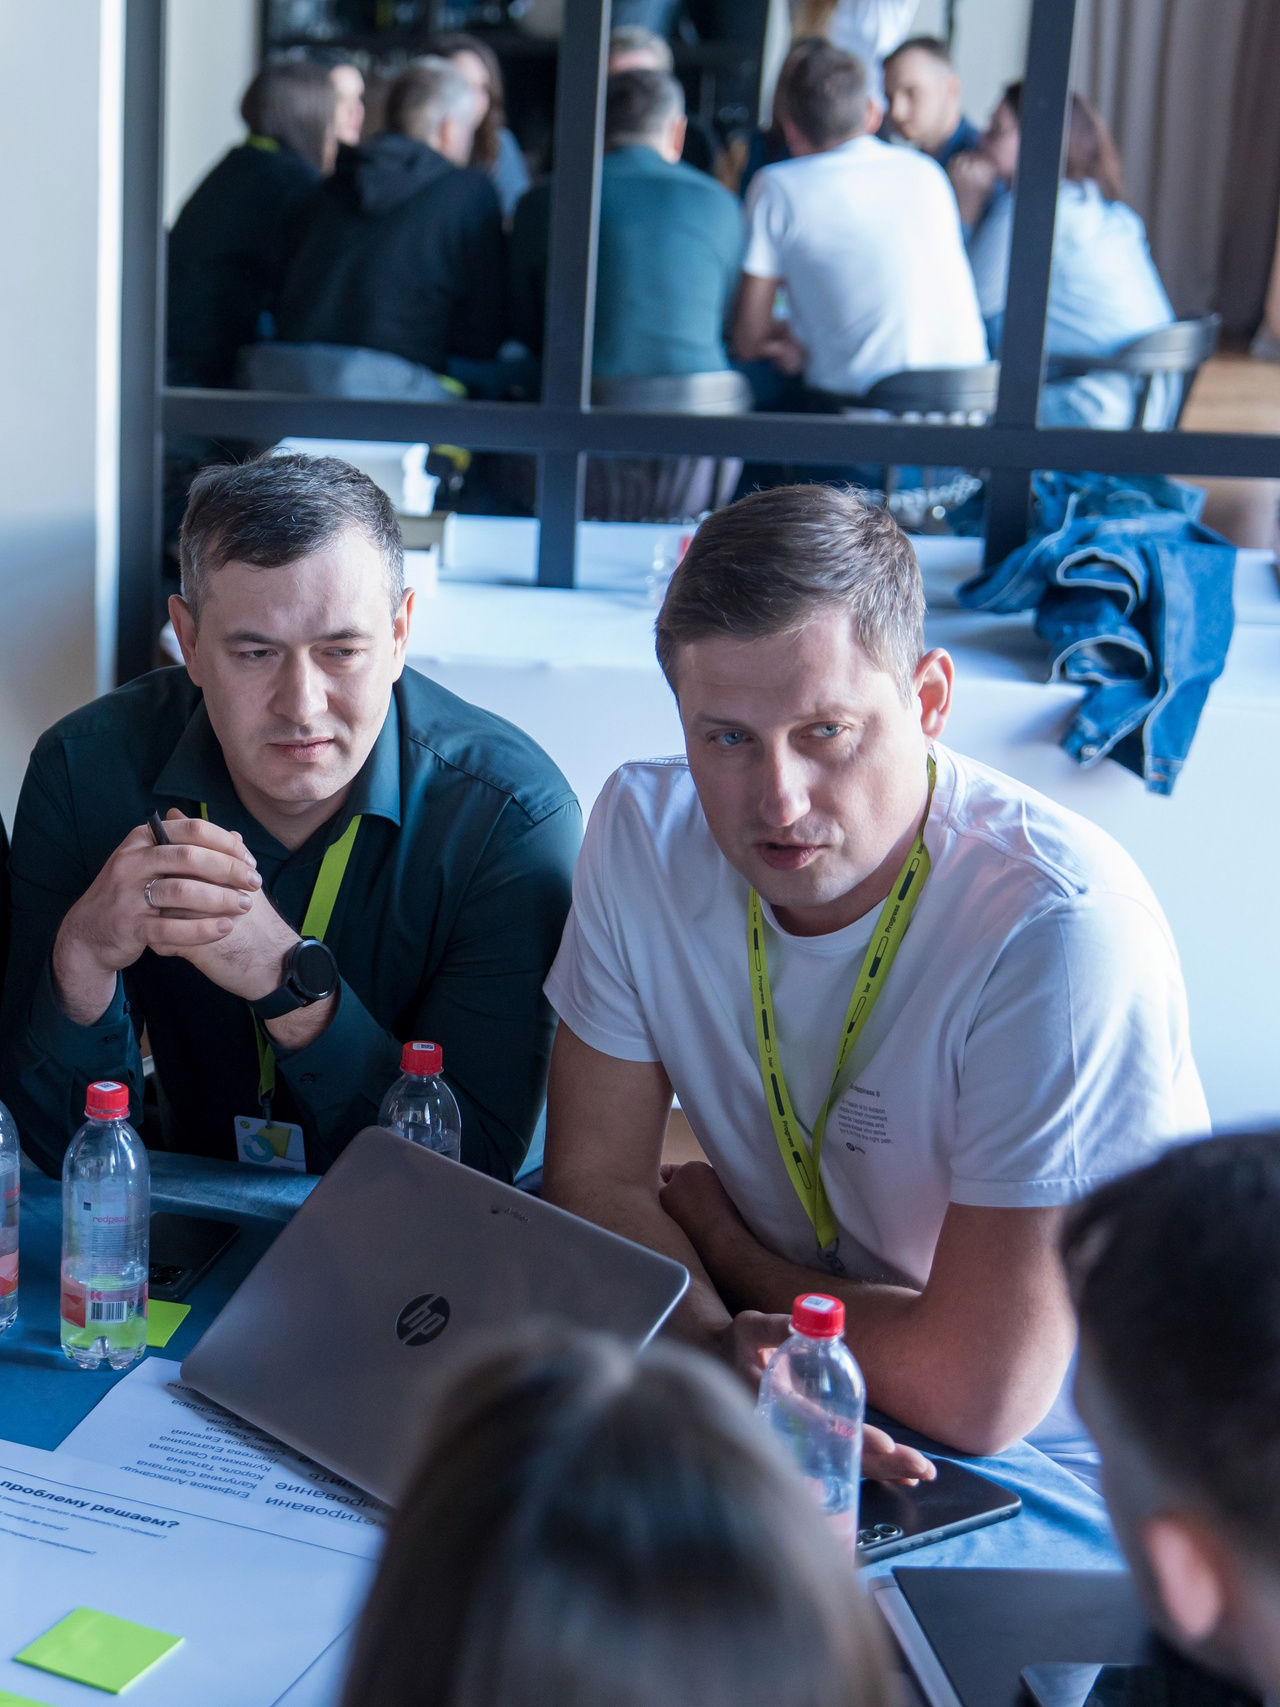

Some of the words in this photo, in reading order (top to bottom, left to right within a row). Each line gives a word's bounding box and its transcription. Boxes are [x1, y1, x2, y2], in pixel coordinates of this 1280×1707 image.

[885, 904, 900, 933] Progress
[863, 982, 871, 993] bar
[782, 1120, 795, 1149] Progress
[93, 1215, 129, 1225] redpeak
[399, 1292, 448, 1345] hp
[170, 1428, 223, 1443] Евгений
[204, 1426, 252, 1440] Андрей
[148, 1442, 209, 1459] Светлана
[158, 1435, 225, 1452] Екатерина
[223, 1439, 286, 1456] Свиридов
[166, 1456, 215, 1470] Татьяна
[210, 1455, 272, 1472] Кулюкина
[226, 1448, 280, 1464] Лаптева
[136, 1459, 198, 1477] Светлана
[219, 1466, 266, 1480] Король
[199, 1472, 258, 1489] Калугина
[189, 1481, 251, 1498] Елфимов
[0, 1480, 91, 1508] проблему
[90, 1504, 180, 1529] решаем?
